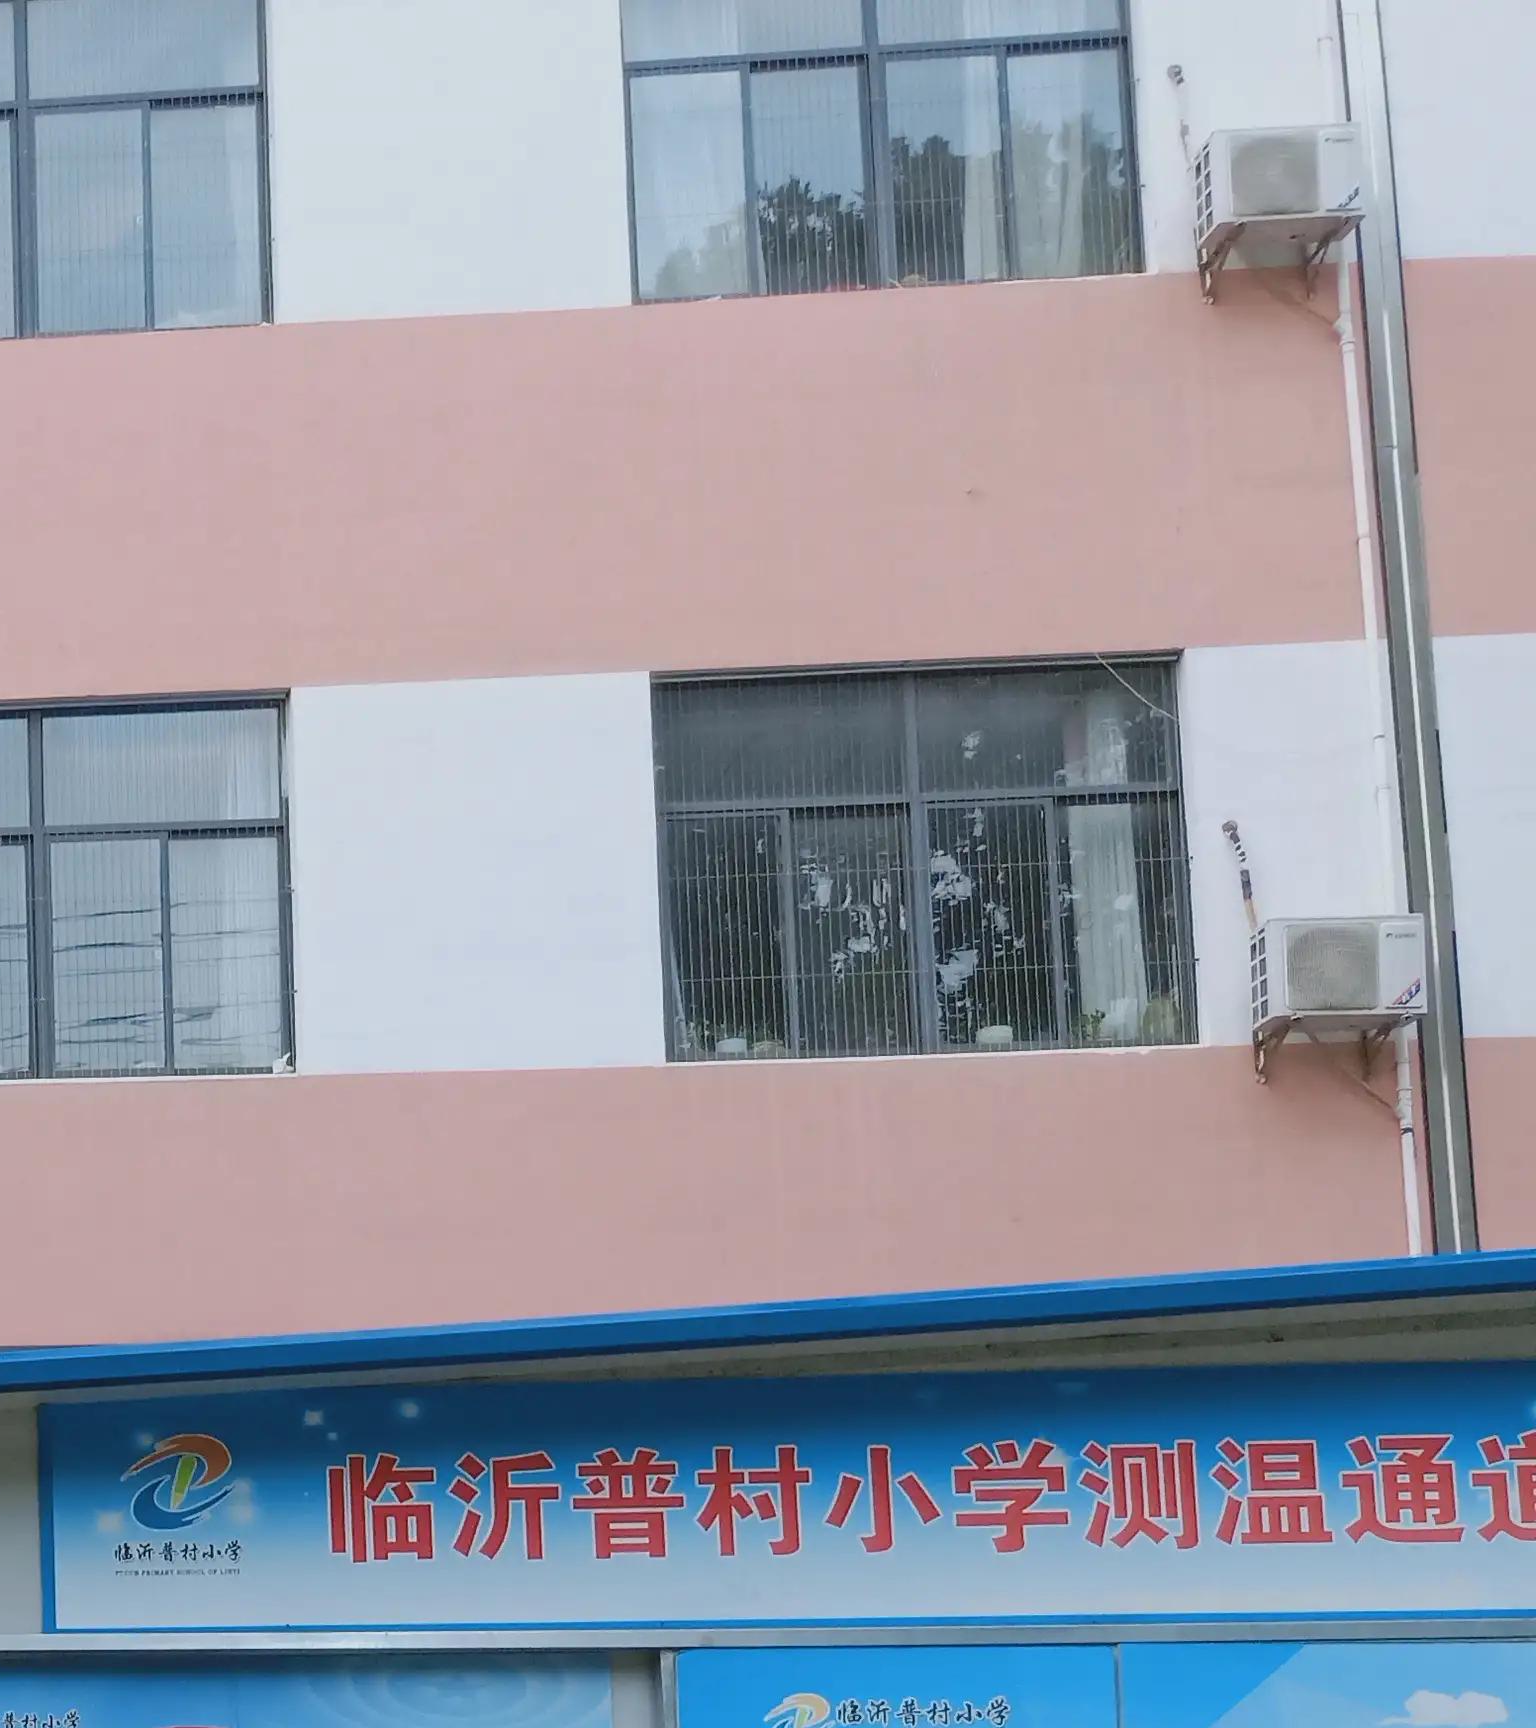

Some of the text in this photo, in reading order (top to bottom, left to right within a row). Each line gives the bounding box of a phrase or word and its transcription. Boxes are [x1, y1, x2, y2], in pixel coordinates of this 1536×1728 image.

[328, 1431, 1536, 1564] 临沂普村小学测温通道
[114, 1540, 242, 1562] 临沂普村小学
[837, 1696, 1010, 1726] 临沂普村小学
